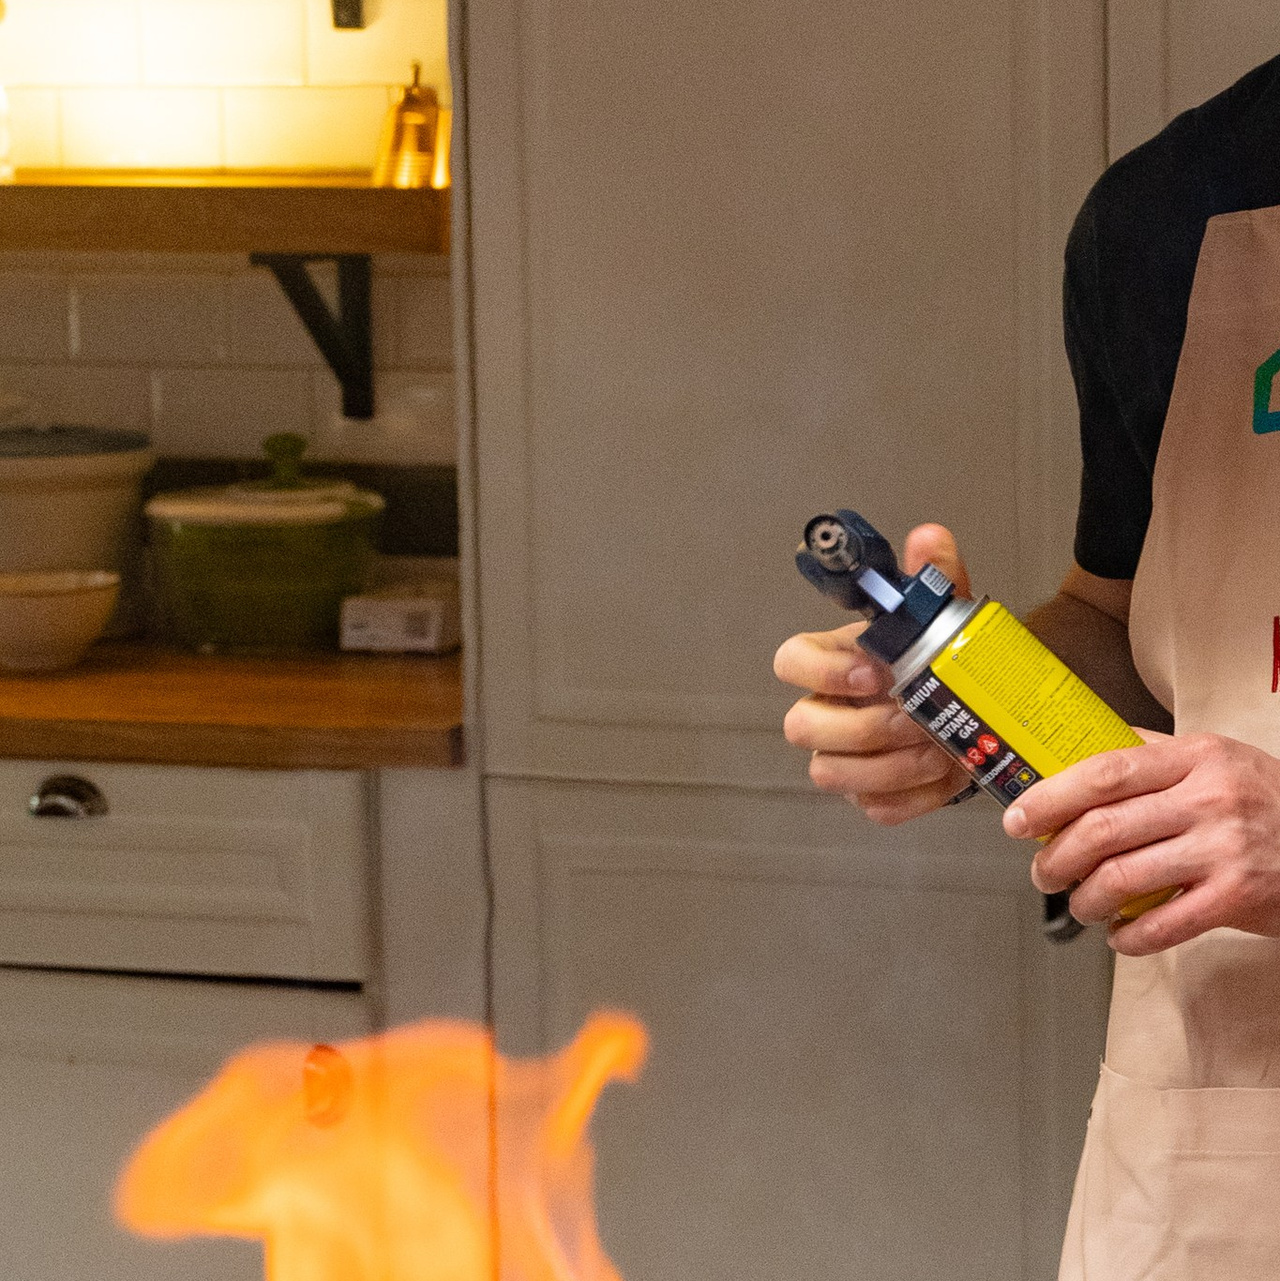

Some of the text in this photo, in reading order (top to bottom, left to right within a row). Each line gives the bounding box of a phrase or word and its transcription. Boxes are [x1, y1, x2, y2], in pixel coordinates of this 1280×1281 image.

[928, 700, 962, 732] PROPAN
[937, 709, 971, 741] BUTANE
[958, 719, 980, 739] GAS
